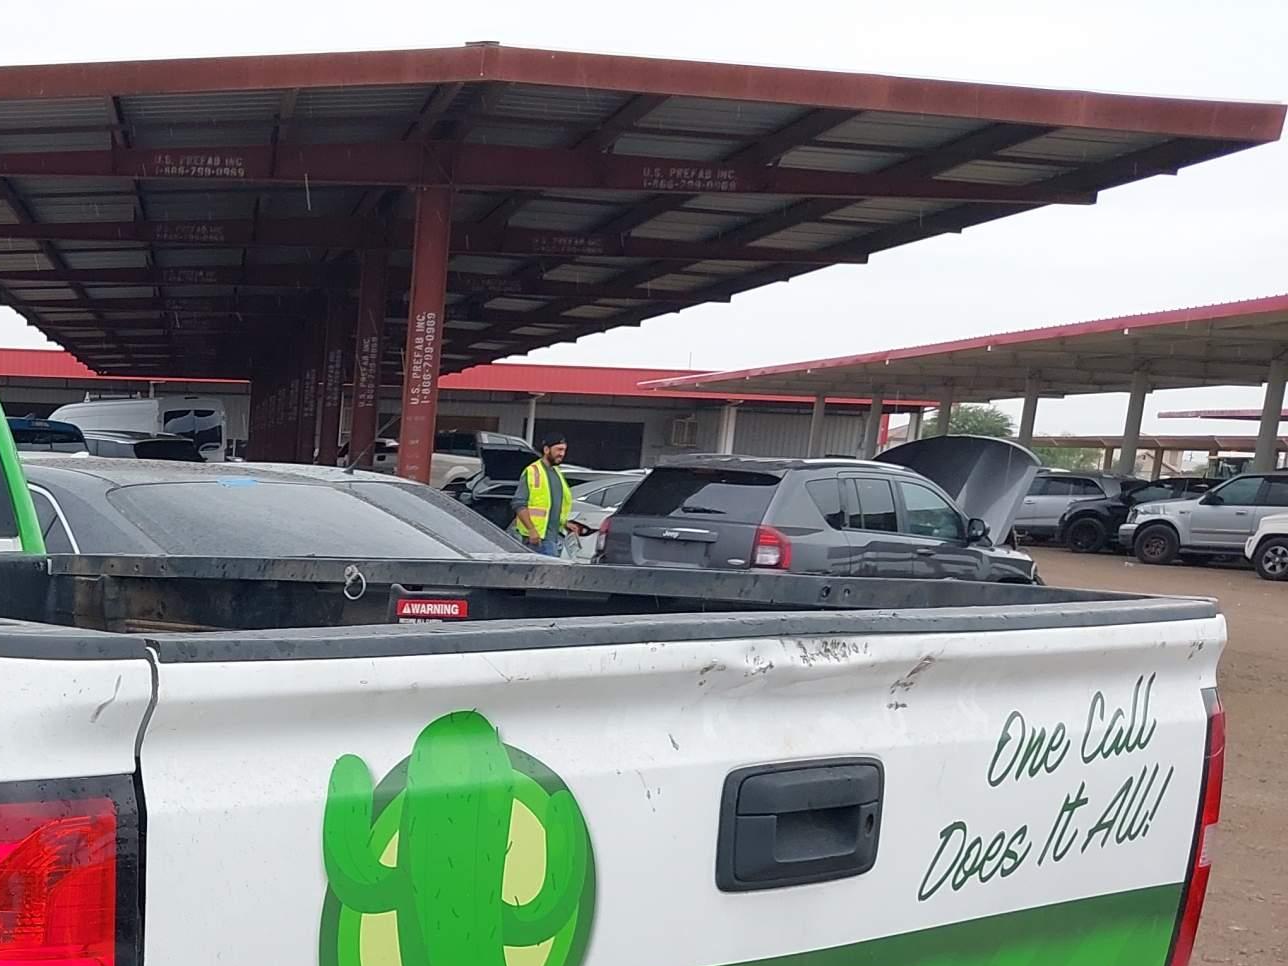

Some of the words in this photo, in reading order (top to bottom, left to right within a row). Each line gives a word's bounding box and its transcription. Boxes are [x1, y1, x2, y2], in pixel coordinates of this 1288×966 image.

[412, 336, 424, 380] PREFAB
[410, 384, 421, 406] U.S.
[410, 603, 460, 615] WARNING
[987, 710, 1071, 788] One
[1081, 672, 1158, 765] Call
[918, 821, 1033, 902] Does
[1038, 781, 1089, 867] It
[1081, 763, 1175, 854] All!
